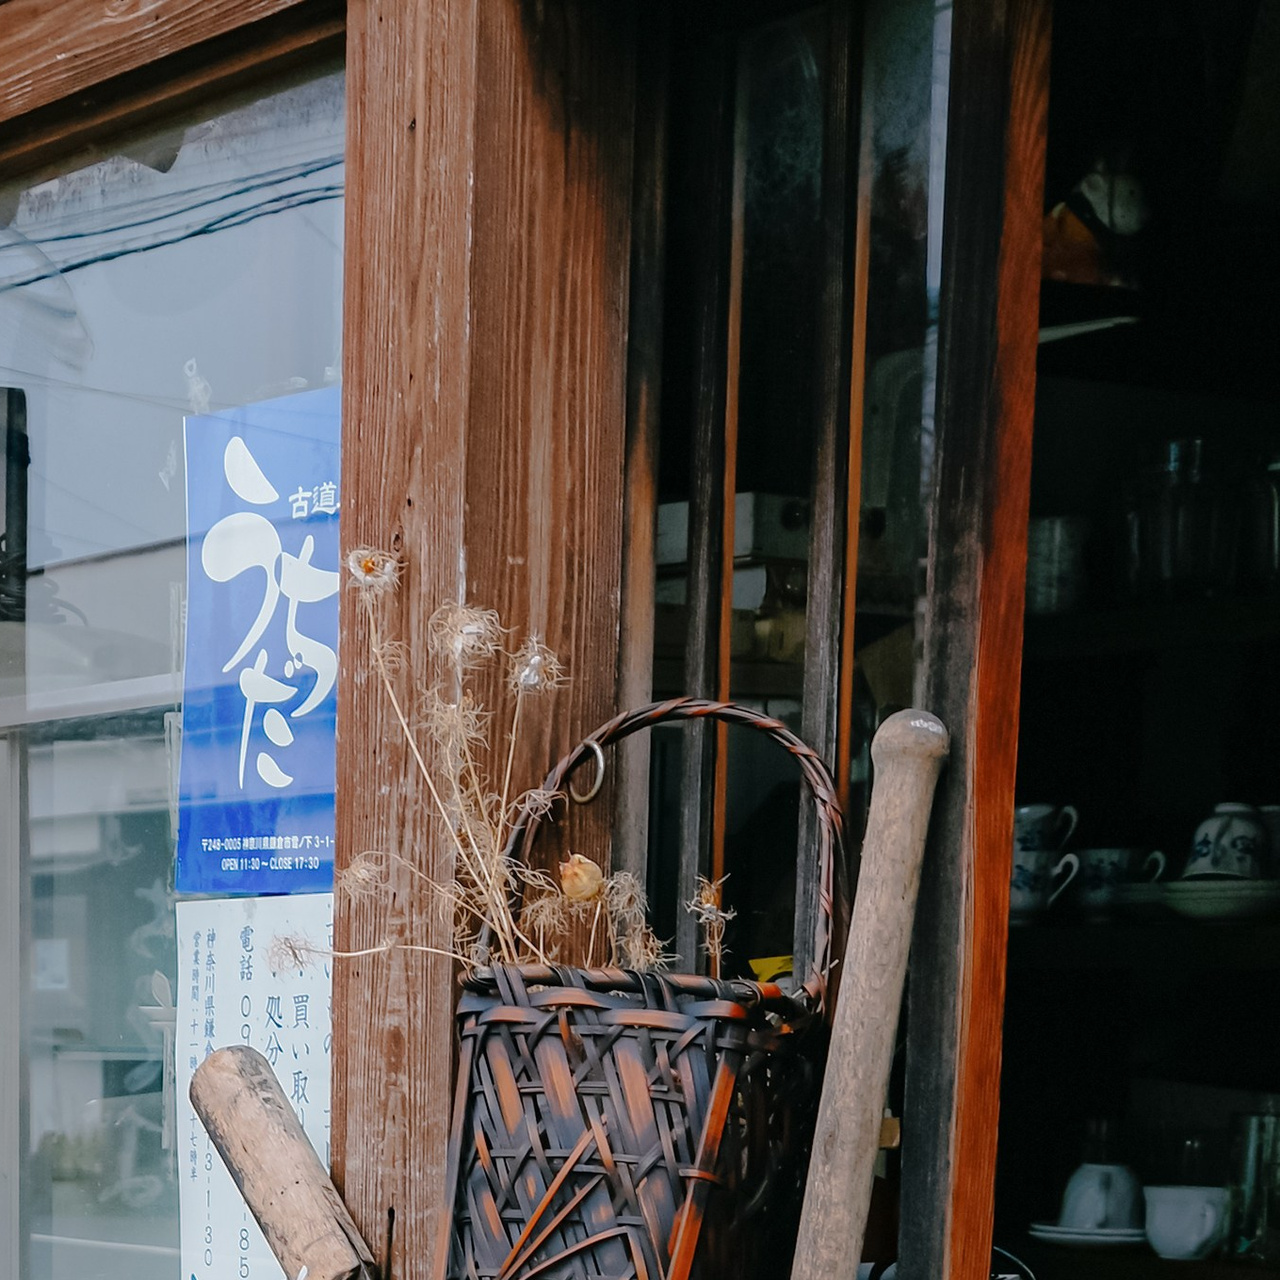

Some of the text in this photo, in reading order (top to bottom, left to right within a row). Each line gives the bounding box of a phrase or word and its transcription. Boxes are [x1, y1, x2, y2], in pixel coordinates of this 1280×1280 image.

[288, 480, 341, 519] 古道
[221, 857, 239, 871] OPEN
[269, 856, 293, 870] CLOSE
[239, 925, 255, 981] 電話
